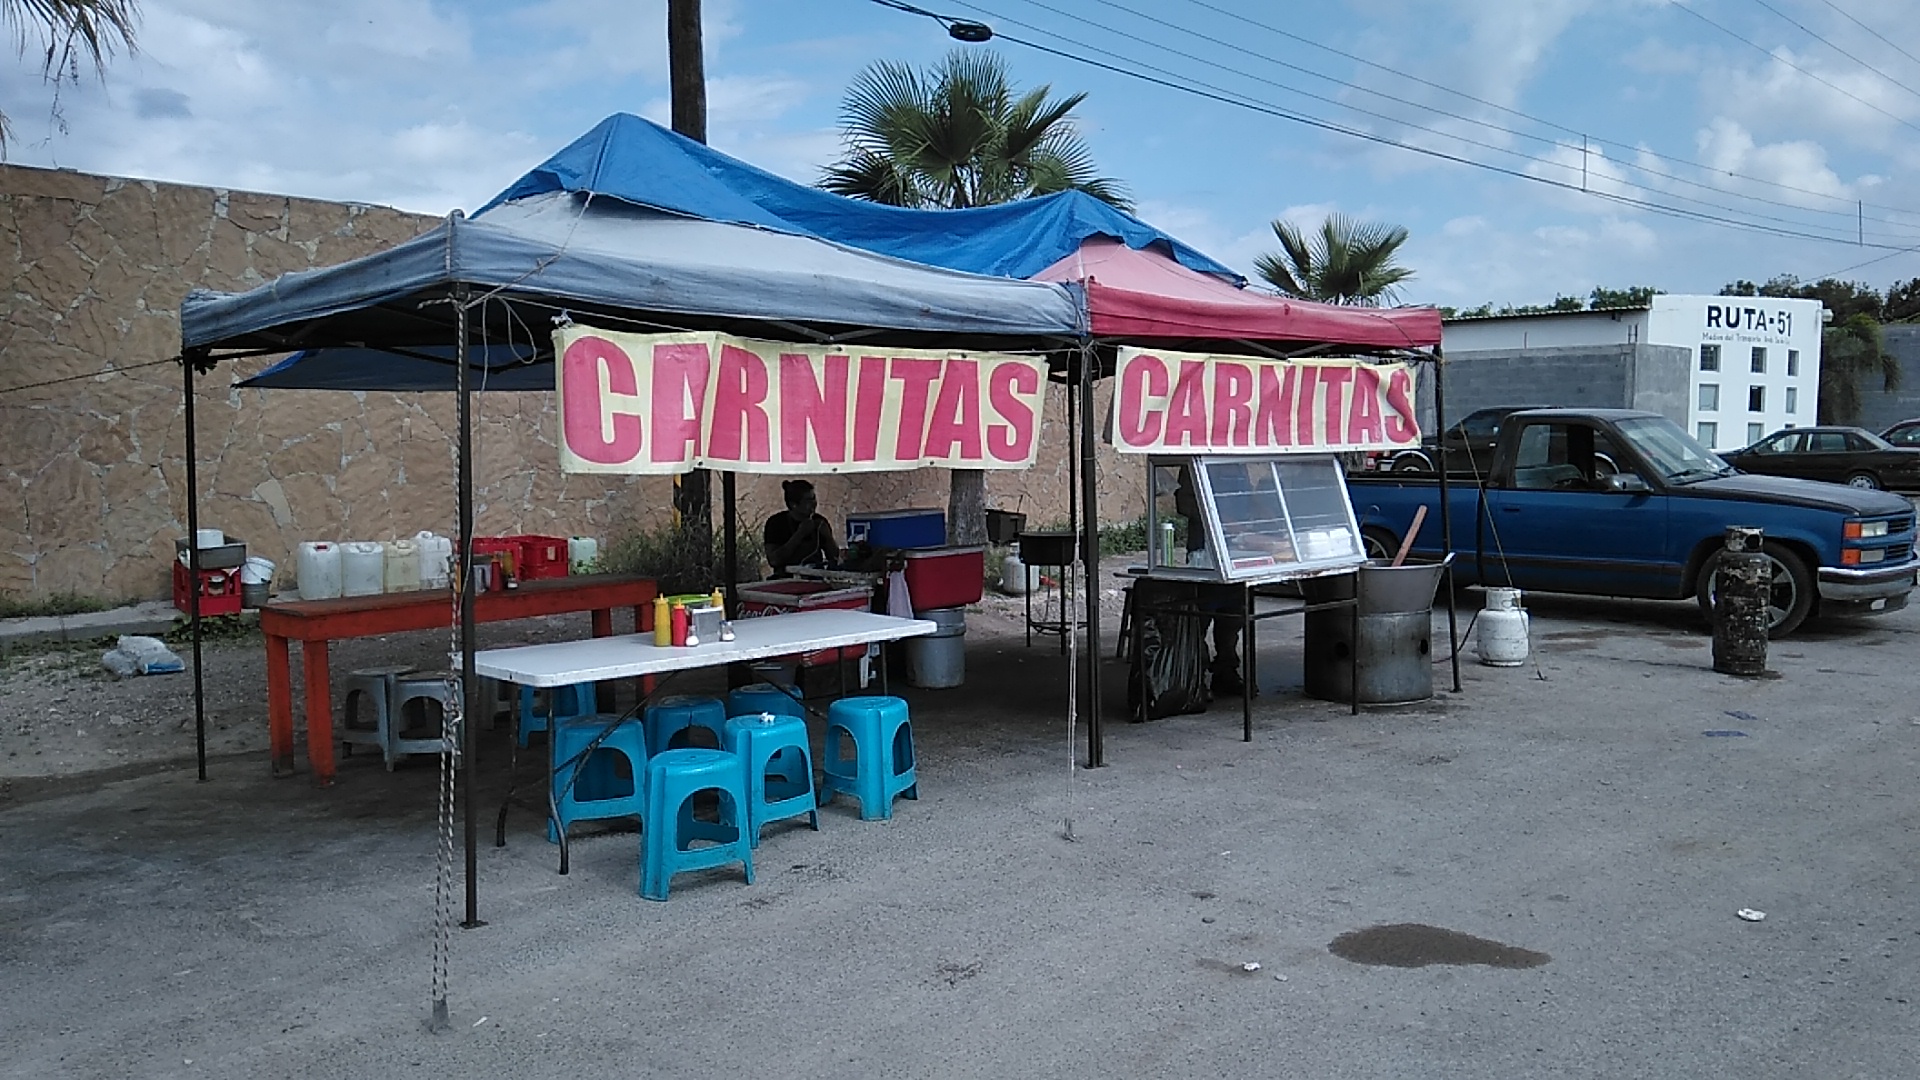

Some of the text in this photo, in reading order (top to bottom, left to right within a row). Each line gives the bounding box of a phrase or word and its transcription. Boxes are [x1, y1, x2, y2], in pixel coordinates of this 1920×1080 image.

[562, 335, 1038, 464] CARNITAS
[1119, 354, 1418, 447] CARNITAS
[736, 601, 792, 620] Coca-C
